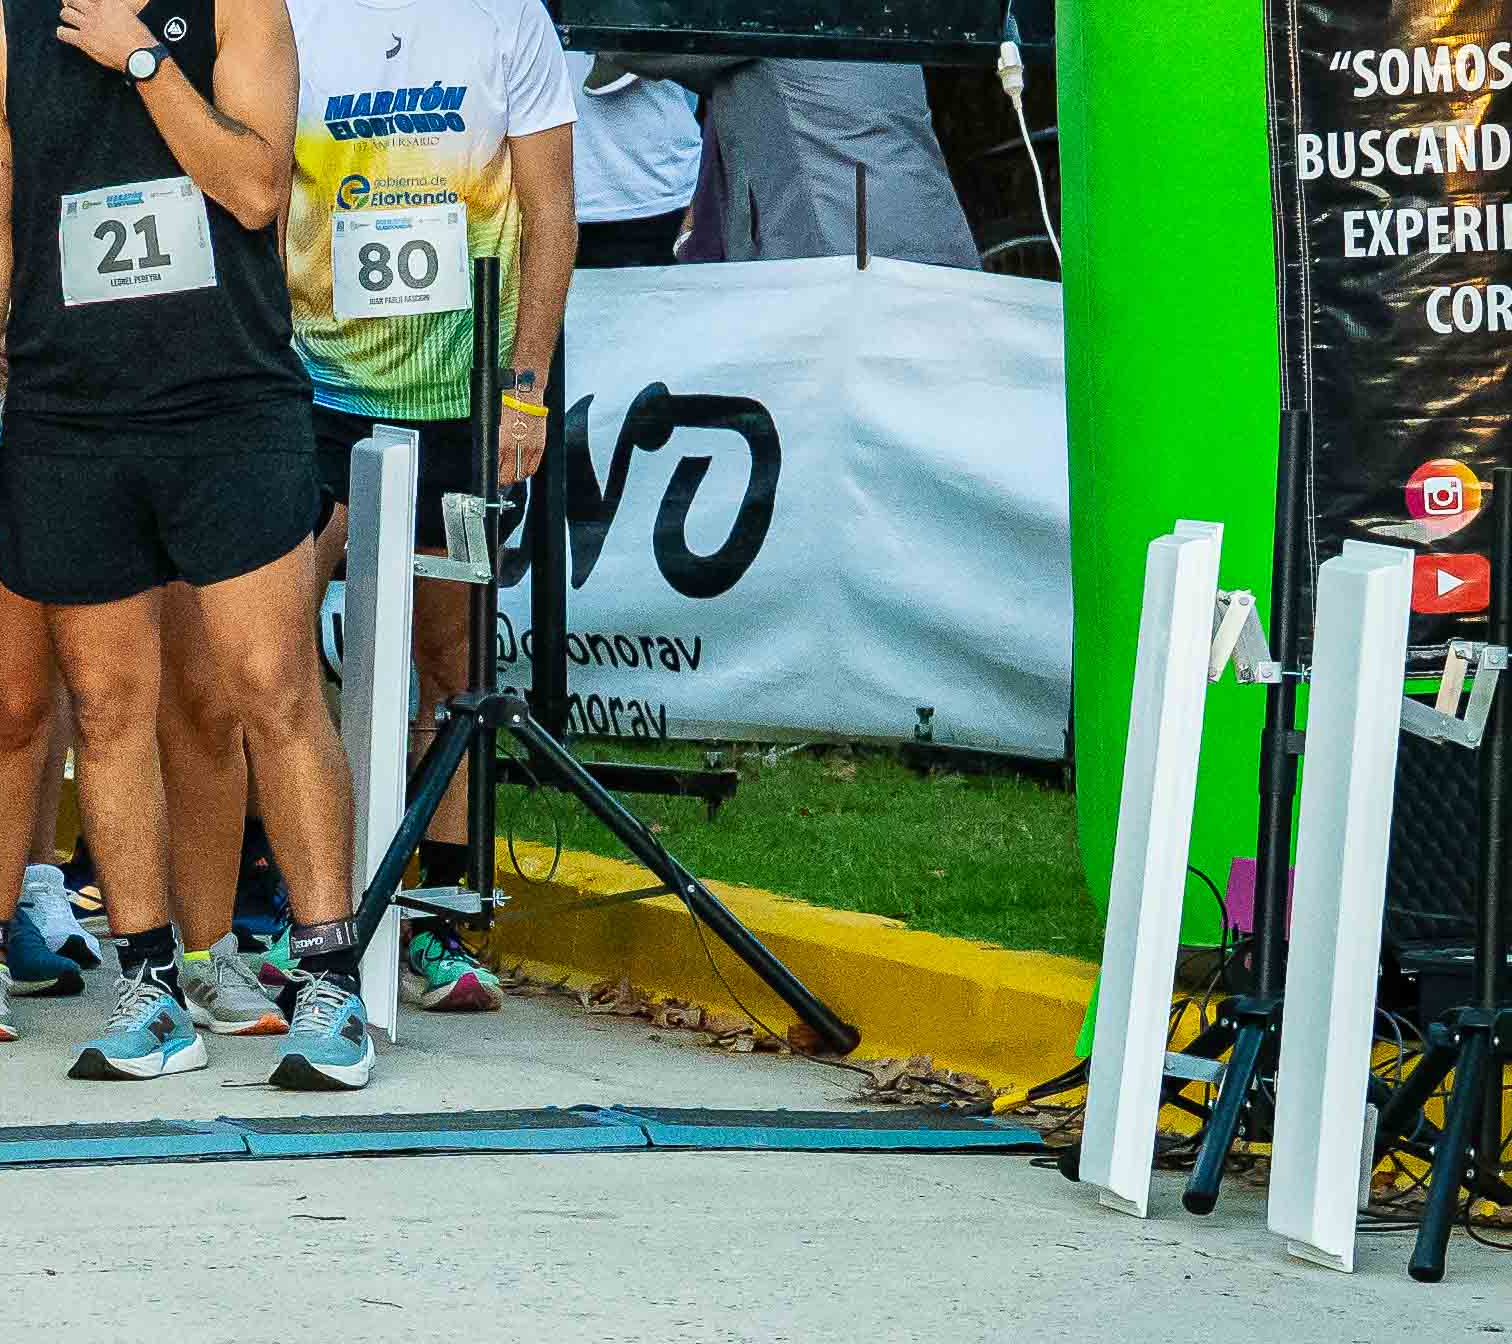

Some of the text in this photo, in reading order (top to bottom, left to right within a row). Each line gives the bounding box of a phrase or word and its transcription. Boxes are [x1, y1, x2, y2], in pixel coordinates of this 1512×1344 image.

[324, 81, 468, 121] MARATÓN
[1298, 122, 1512, 180] BUSCAND
[371, 190, 458, 207] Elortondo
[94, 214, 171, 274] 21
[359, 239, 439, 291] 80
